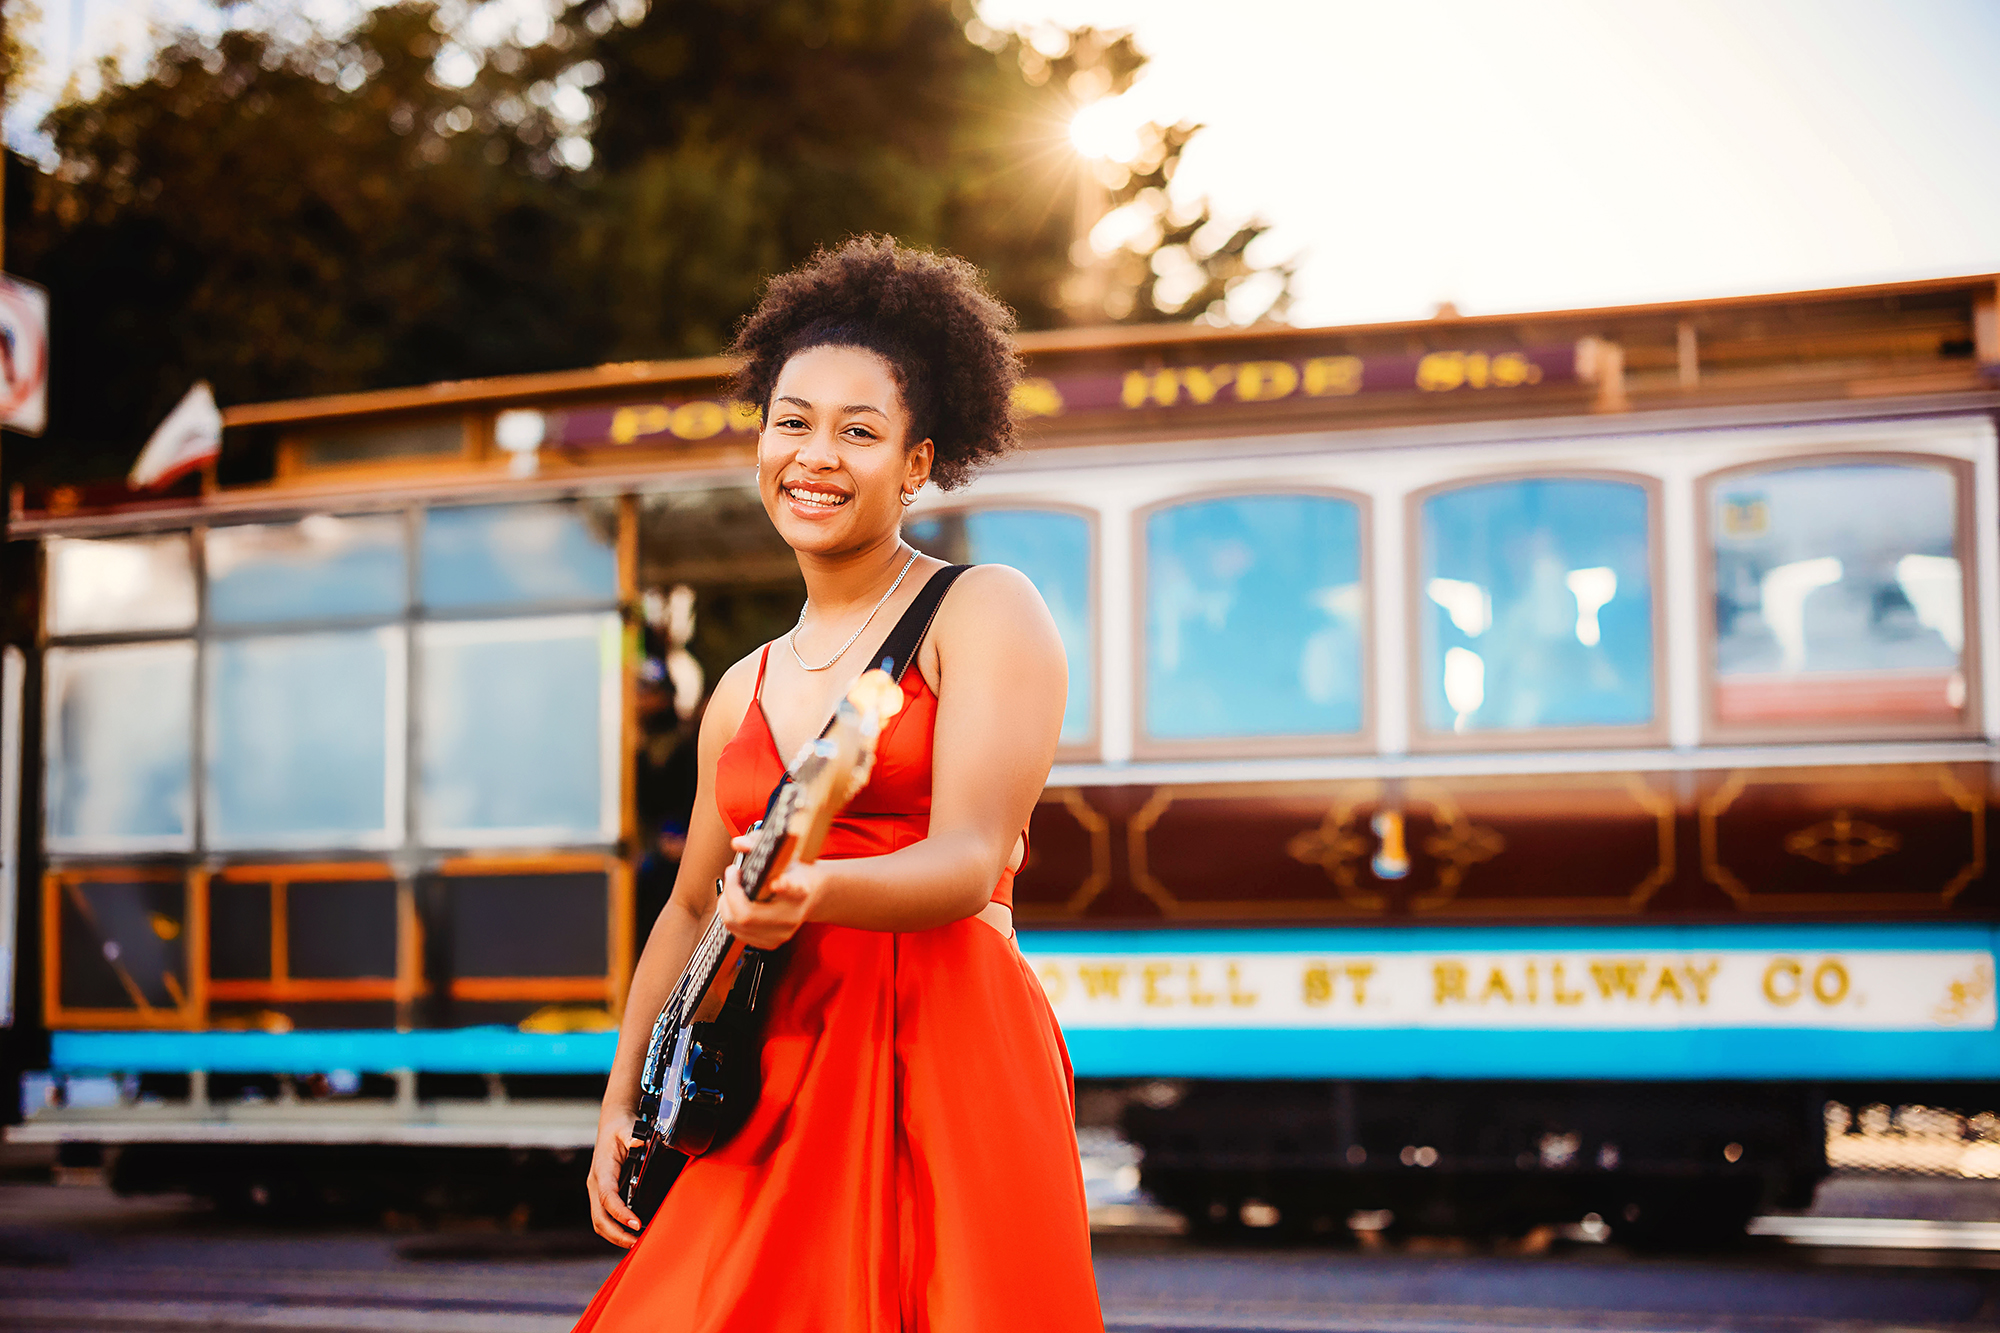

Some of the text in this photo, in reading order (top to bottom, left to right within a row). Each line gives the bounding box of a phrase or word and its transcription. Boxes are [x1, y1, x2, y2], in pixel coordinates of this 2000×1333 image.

[1122, 355, 1363, 409] HYDE
[1039, 960, 1260, 1008] OWELL
[1429, 958, 1723, 1008] RAILWAY
[1760, 955, 1867, 1009] CO.
